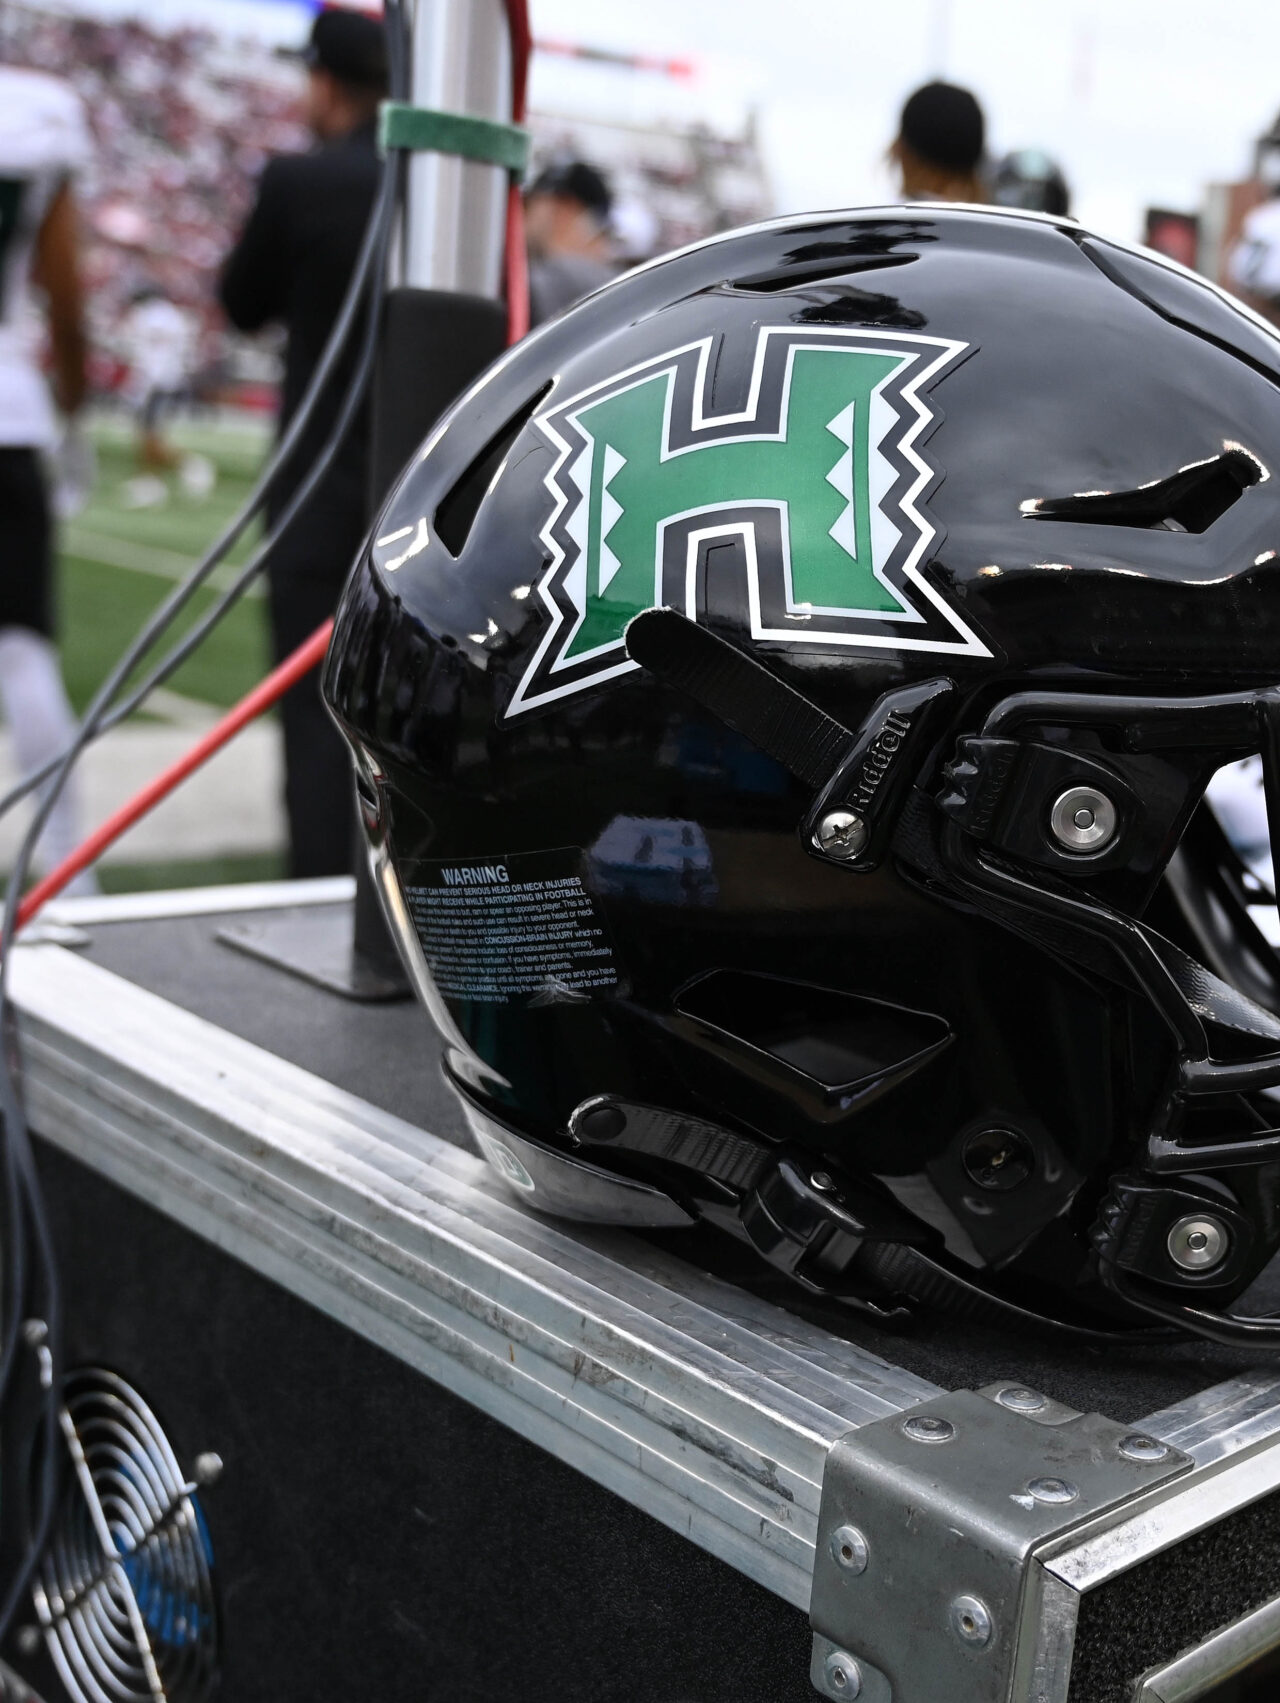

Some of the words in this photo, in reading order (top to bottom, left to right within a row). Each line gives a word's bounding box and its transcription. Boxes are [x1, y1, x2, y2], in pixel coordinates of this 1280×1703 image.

[504, 326, 995, 719] H
[441, 864, 510, 886] WARNING
[439, 888, 463, 897] PREVENT
[463, 886, 491, 897] SERIOUS
[491, 884, 511, 895] HEAD
[511, 883, 523, 893] OR
[523, 881, 545, 892] NECK
[545, 876, 582, 890] INJURIES
[485, 892, 535, 906] PARTICIPATING
[534, 891, 544, 902] IN
[561, 898, 577, 909] This
[577, 898, 585, 907] is
[585, 896, 593, 905] in
[551, 910, 569, 920] head
[577, 907, 594, 918] neck
[533, 923, 547, 933] your
[548, 930, 573, 941] INJURY
[574, 928, 594, 938] which
[594, 928, 604, 936] no
[513, 955, 523, 965] you
[574, 947, 613, 958] immediately
[534, 963, 547, 972] and
[555, 971, 572, 981] gone
[572, 969, 586, 978] and
[586, 969, 600, 979] you
[599, 967, 617, 975] have
[570, 980, 584, 989] lead
[592, 977, 618, 987] another
